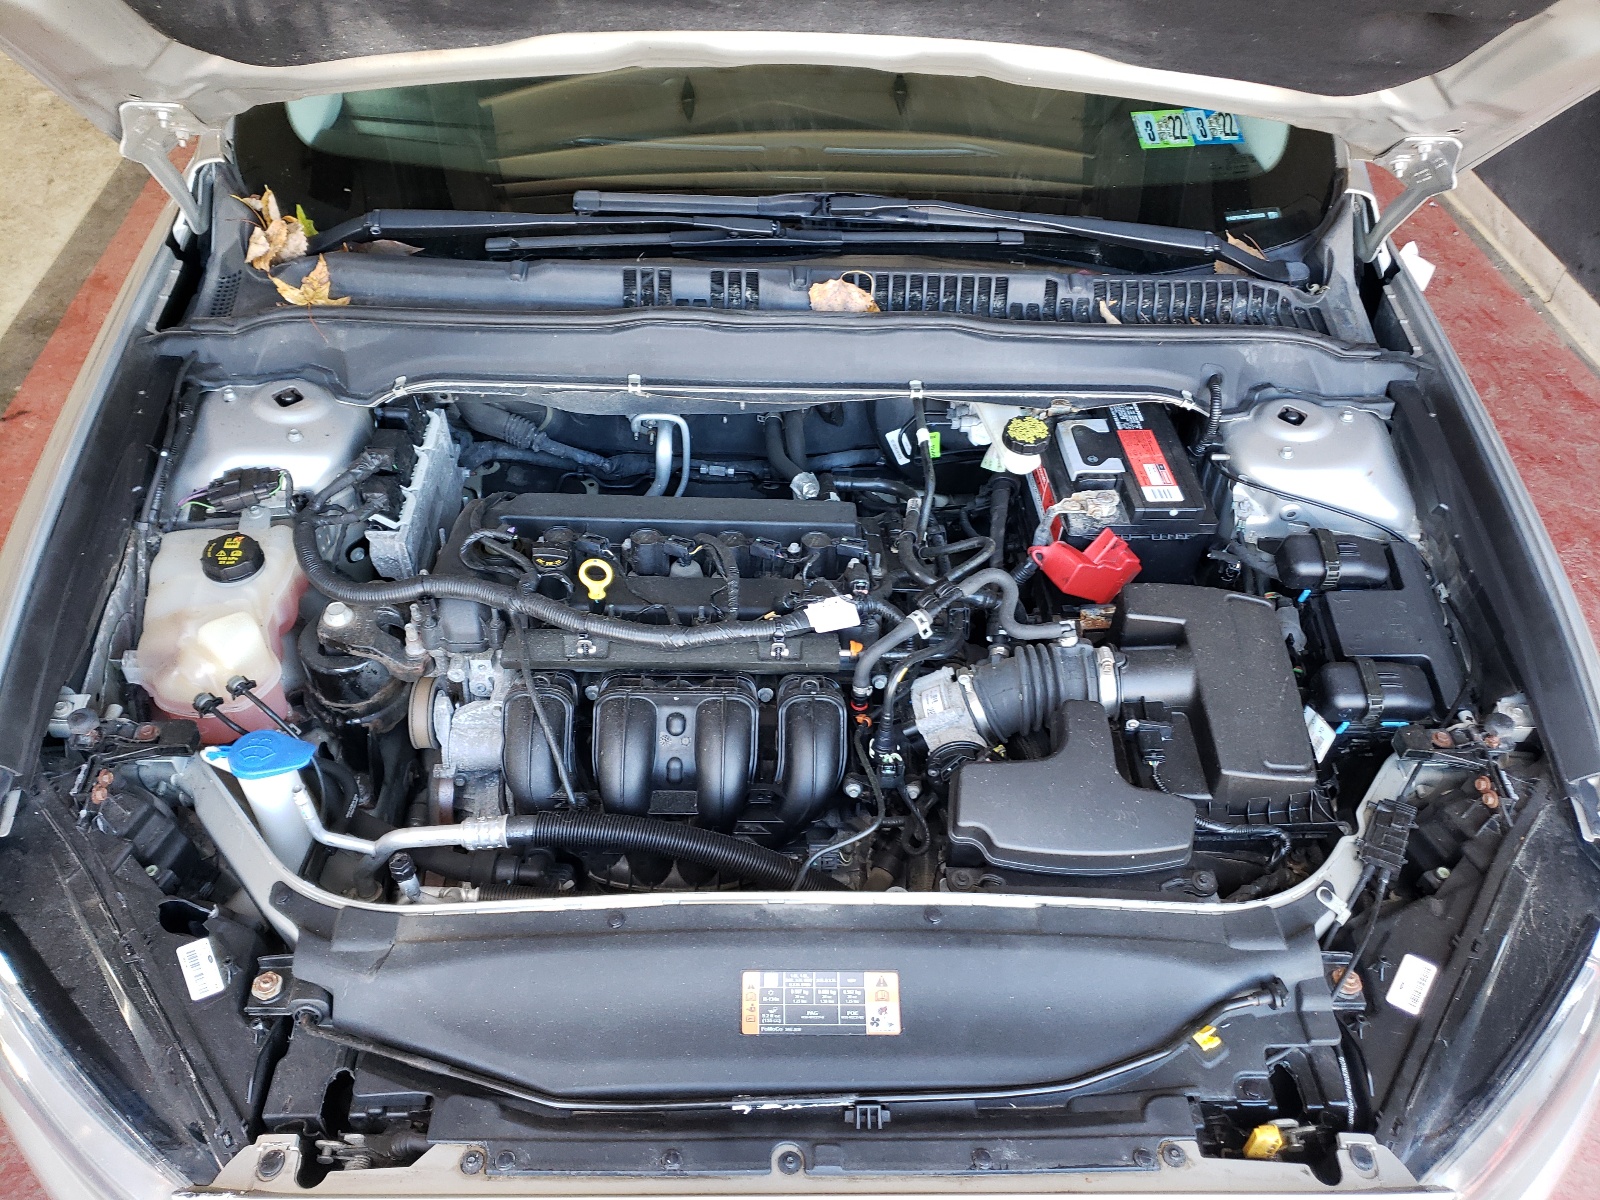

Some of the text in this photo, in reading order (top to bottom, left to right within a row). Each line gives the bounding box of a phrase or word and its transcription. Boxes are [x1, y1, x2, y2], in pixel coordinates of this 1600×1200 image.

[1145, 120, 1156, 142] 3
[1167, 115, 1188, 140] 22
[1196, 116, 1208, 139] 3
[1217, 111, 1238, 137] 22
